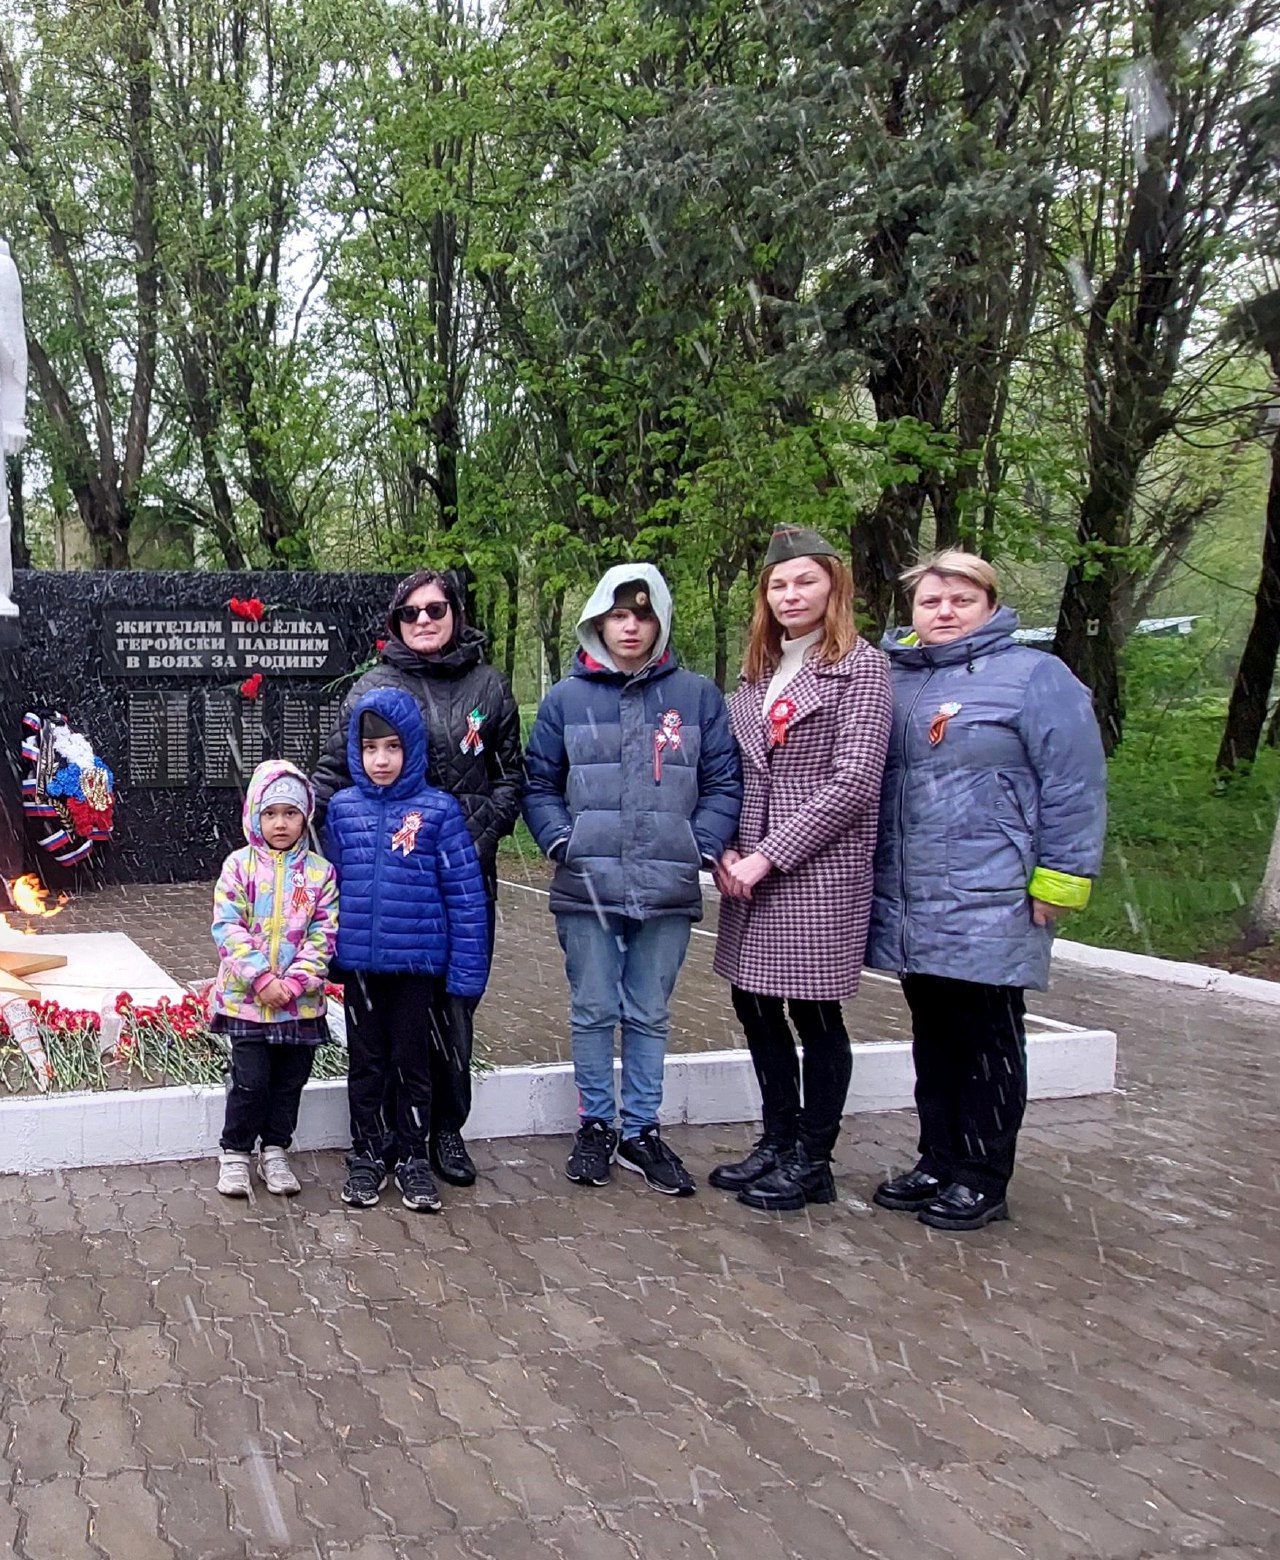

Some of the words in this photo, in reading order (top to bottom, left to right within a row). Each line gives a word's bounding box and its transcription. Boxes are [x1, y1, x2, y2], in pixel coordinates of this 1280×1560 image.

[116, 621, 223, 634] ЖИТЕЛЯМ
[116, 635, 225, 651] ГЕРОЙСКИ
[237, 638, 329, 651] ПАВШИМ
[126, 656, 140, 668] В
[148, 655, 203, 668] БОЯХ
[211, 655, 237, 668] ЗА
[245, 654, 328, 670] РОДИНУ
